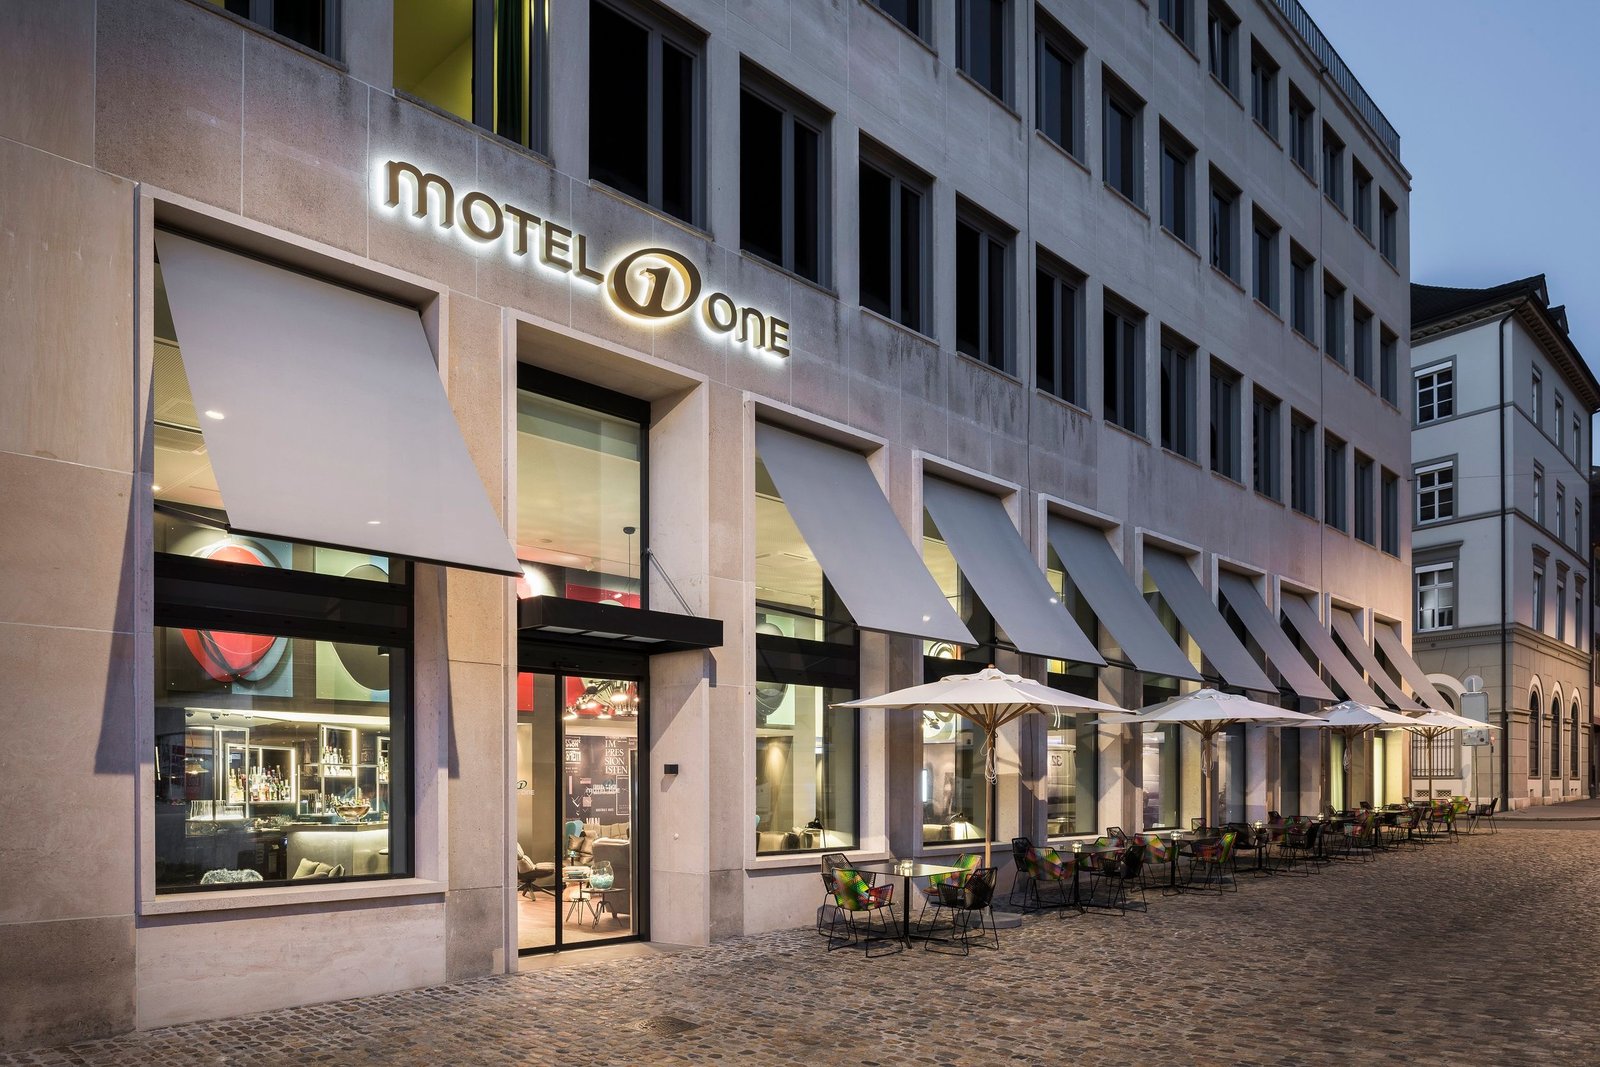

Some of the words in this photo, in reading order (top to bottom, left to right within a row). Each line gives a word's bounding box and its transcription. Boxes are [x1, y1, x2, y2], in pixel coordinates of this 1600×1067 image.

[384, 160, 604, 286] MOTEL
[702, 291, 790, 358] ONE
[605, 740, 616, 748] IM
[605, 749, 624, 757] PRES
[605, 757, 626, 766] SION
[605, 766, 628, 774] ISTEN
